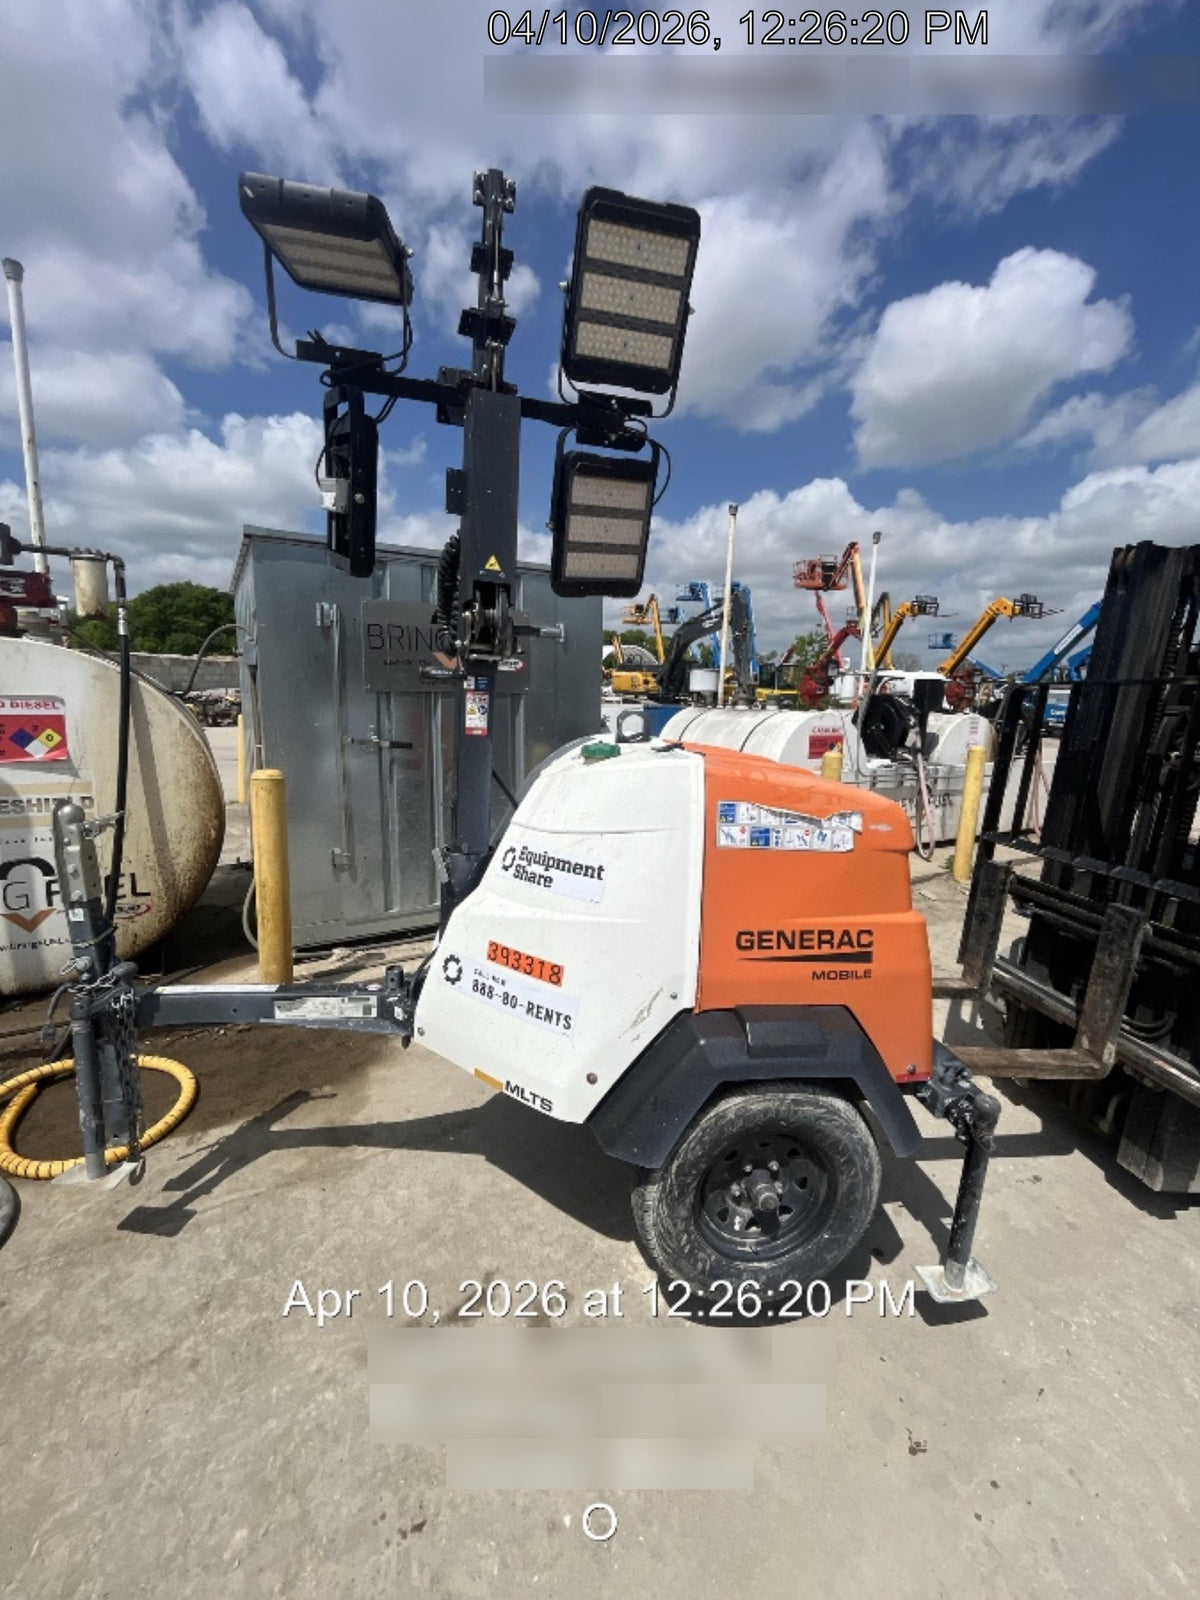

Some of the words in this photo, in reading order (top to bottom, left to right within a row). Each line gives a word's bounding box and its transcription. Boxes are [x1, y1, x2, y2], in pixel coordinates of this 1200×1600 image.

[10, 699, 59, 710] DIESEL
[512, 863, 554, 888] Share
[518, 845, 606, 881] Equipment
[735, 929, 874, 951] GENERAC
[487, 941, 563, 987] 393318
[811, 969, 873, 981] MOBILE
[472, 978, 572, 1030] 888-80-RENTS
[505, 1080, 554, 1112] MLTS
